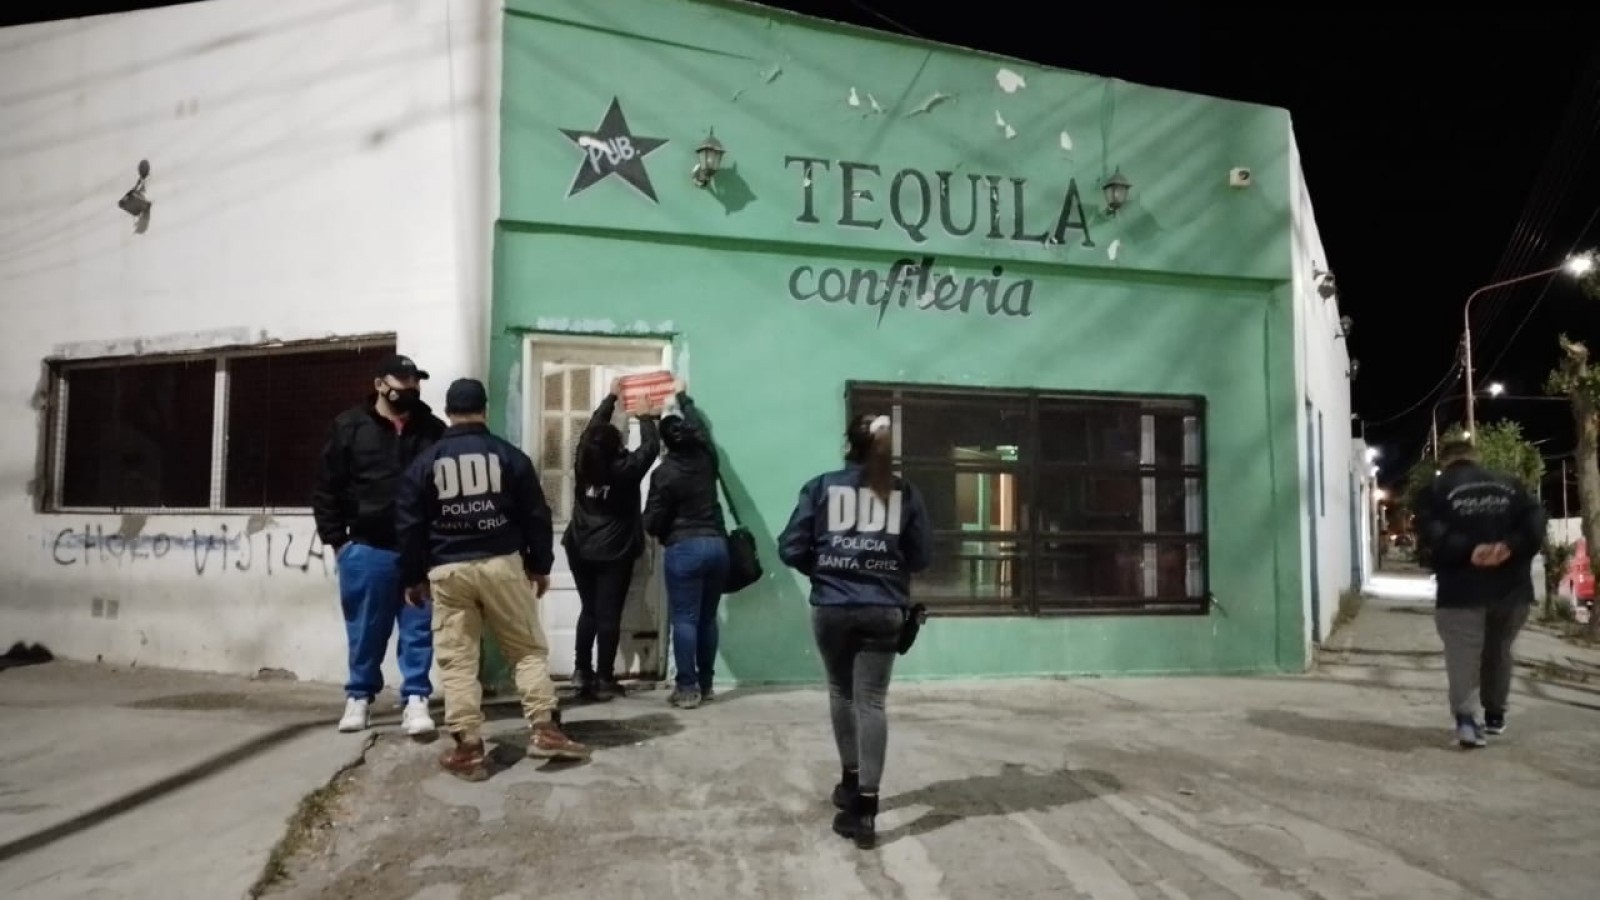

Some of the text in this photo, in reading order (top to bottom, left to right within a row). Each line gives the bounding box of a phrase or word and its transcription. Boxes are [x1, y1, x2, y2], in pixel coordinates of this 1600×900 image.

[784, 155, 1095, 247] TEQUILA
[433, 452, 501, 500] DDI
[442, 500, 495, 515] POLICIA
[827, 485, 903, 535] DDI
[832, 535, 887, 552] POLICIA
[818, 554, 899, 571] SANTA CRUZ
